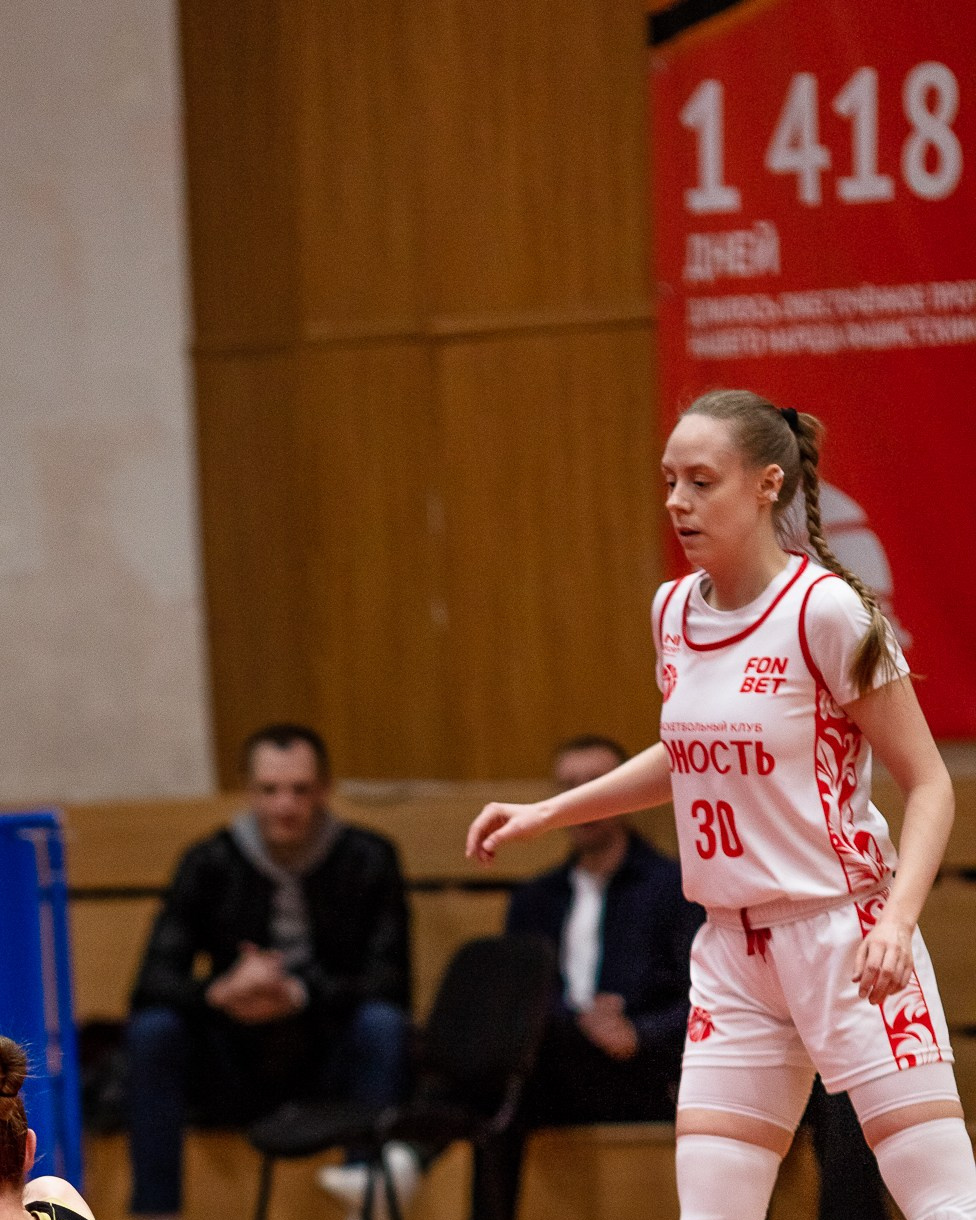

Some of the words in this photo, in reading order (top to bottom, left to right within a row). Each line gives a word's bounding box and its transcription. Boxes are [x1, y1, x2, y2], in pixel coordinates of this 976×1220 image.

[679, 78, 743, 215] 1
[764, 60, 964, 208] 418
[739, 676, 787, 694] BET
[744, 657, 789, 674] FON
[691, 799, 744, 860] 30
